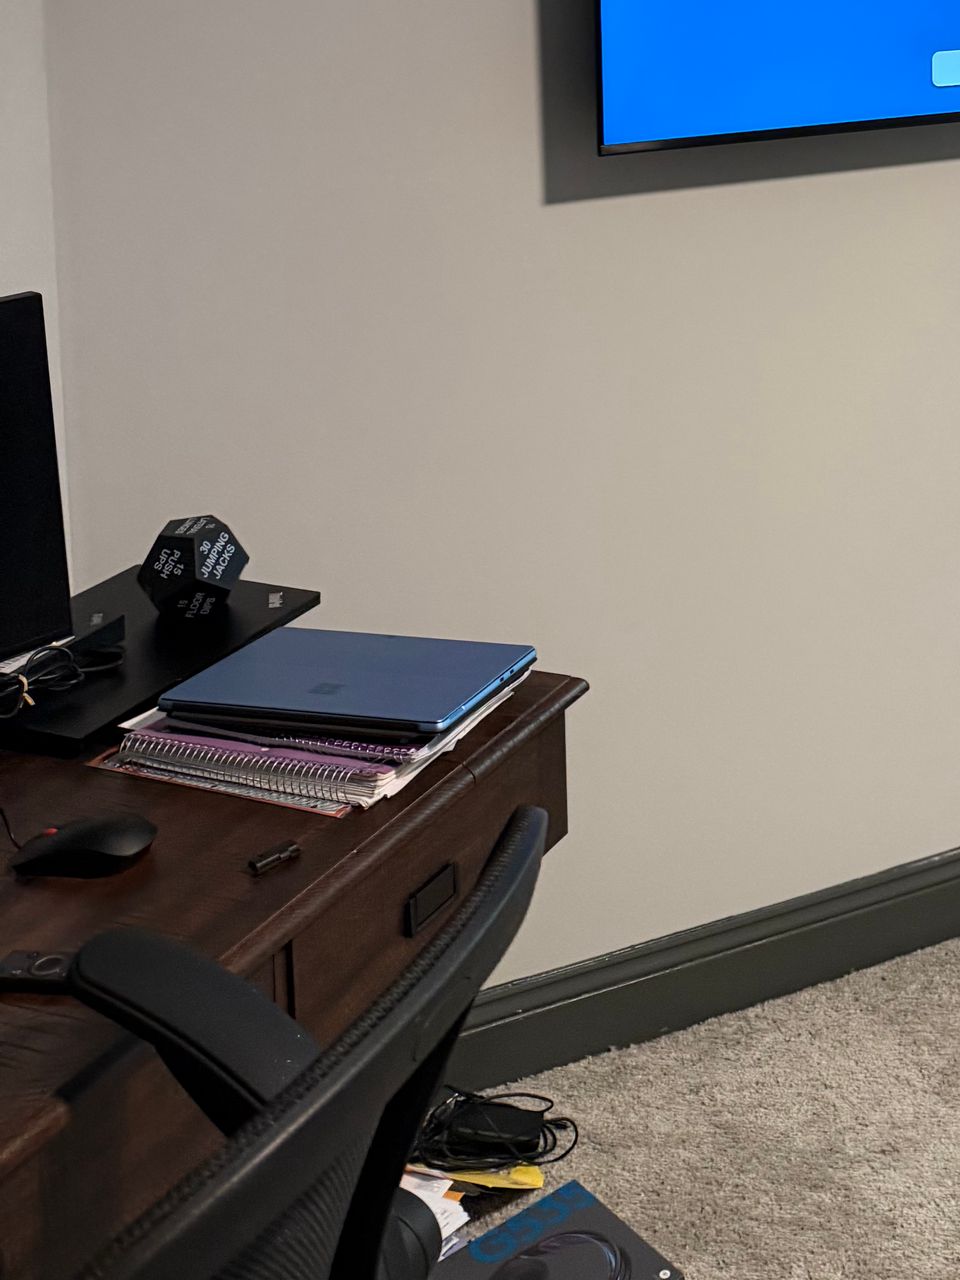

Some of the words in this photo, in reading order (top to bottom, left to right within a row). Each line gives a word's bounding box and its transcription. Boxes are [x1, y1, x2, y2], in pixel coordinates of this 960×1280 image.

[154, 549, 171, 570] UPS
[200, 541, 211, 554] 30
[200, 532, 229, 578] JUMPING
[160, 549, 181, 579] PUSH
[173, 563, 184, 576] 15
[213, 544, 235, 579] JACKS
